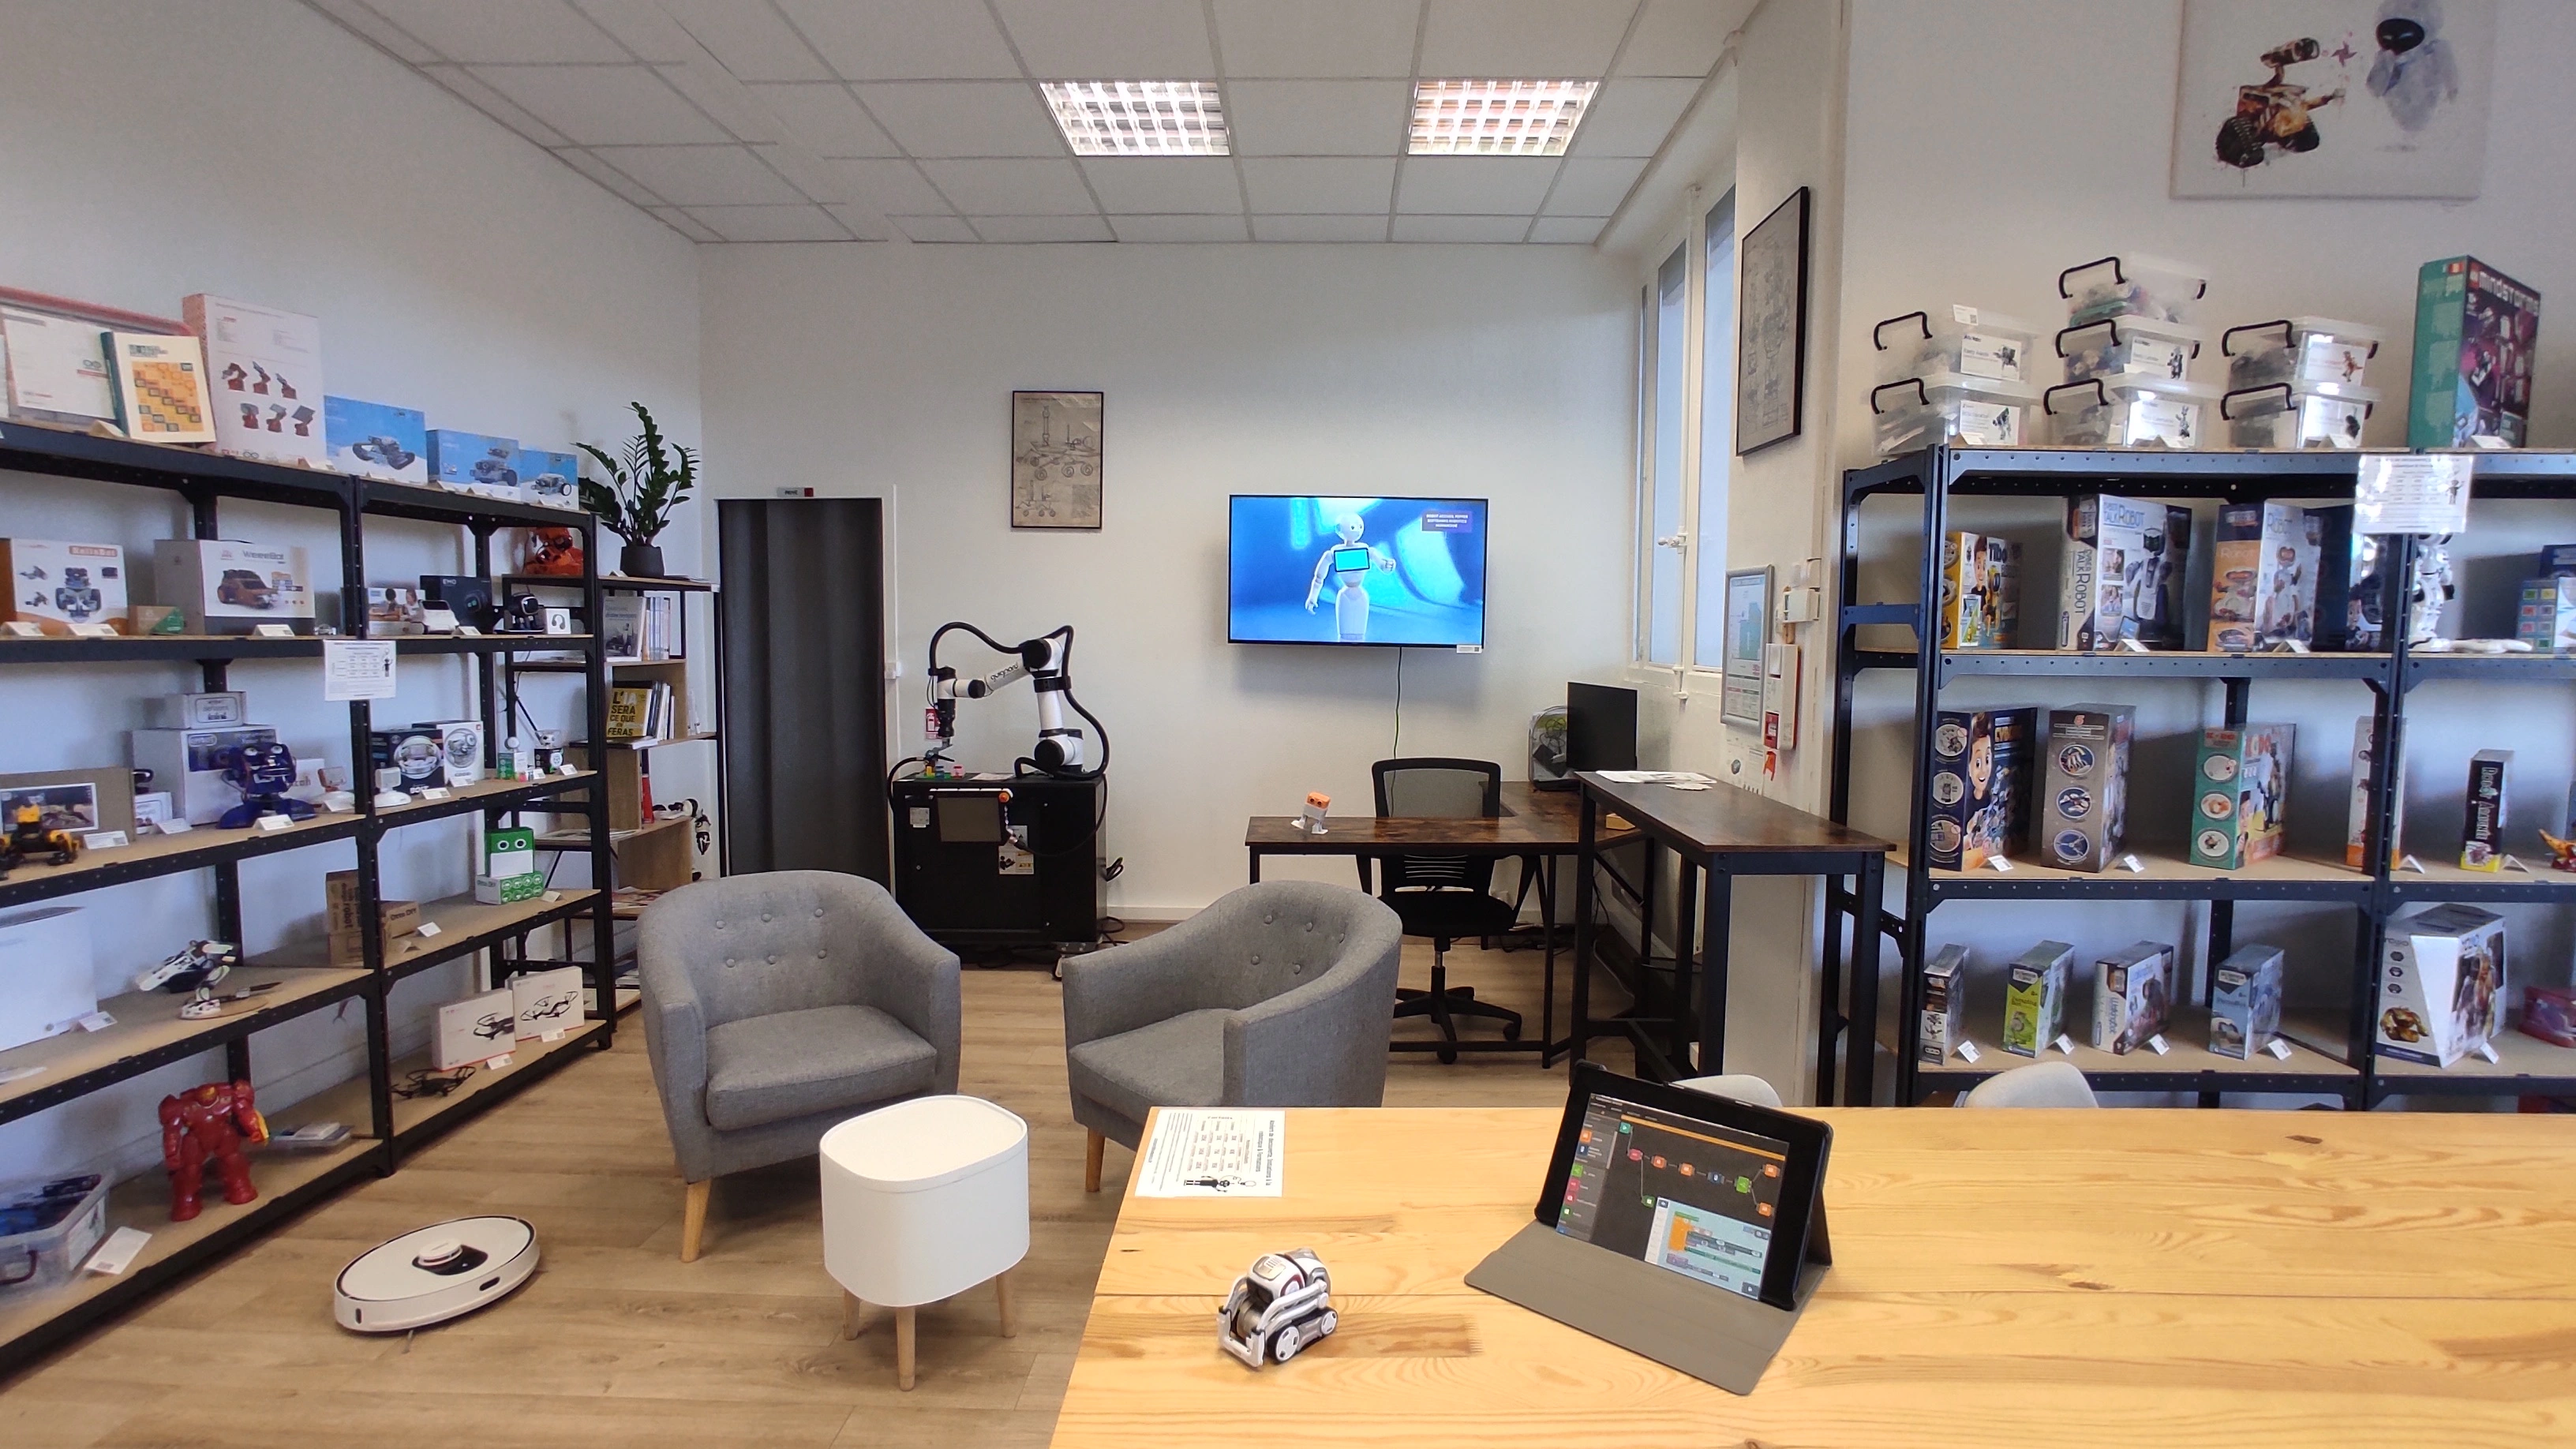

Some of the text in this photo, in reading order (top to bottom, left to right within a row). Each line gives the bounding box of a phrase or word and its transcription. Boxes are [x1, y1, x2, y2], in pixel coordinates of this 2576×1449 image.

[2084, 549, 2093, 571] CYBER
[2074, 550, 2091, 616] TALK ROBOT
[611, 705, 636, 715] SERA
[620, 714, 636, 723] QUE
[607, 727, 634, 736] FERAS
